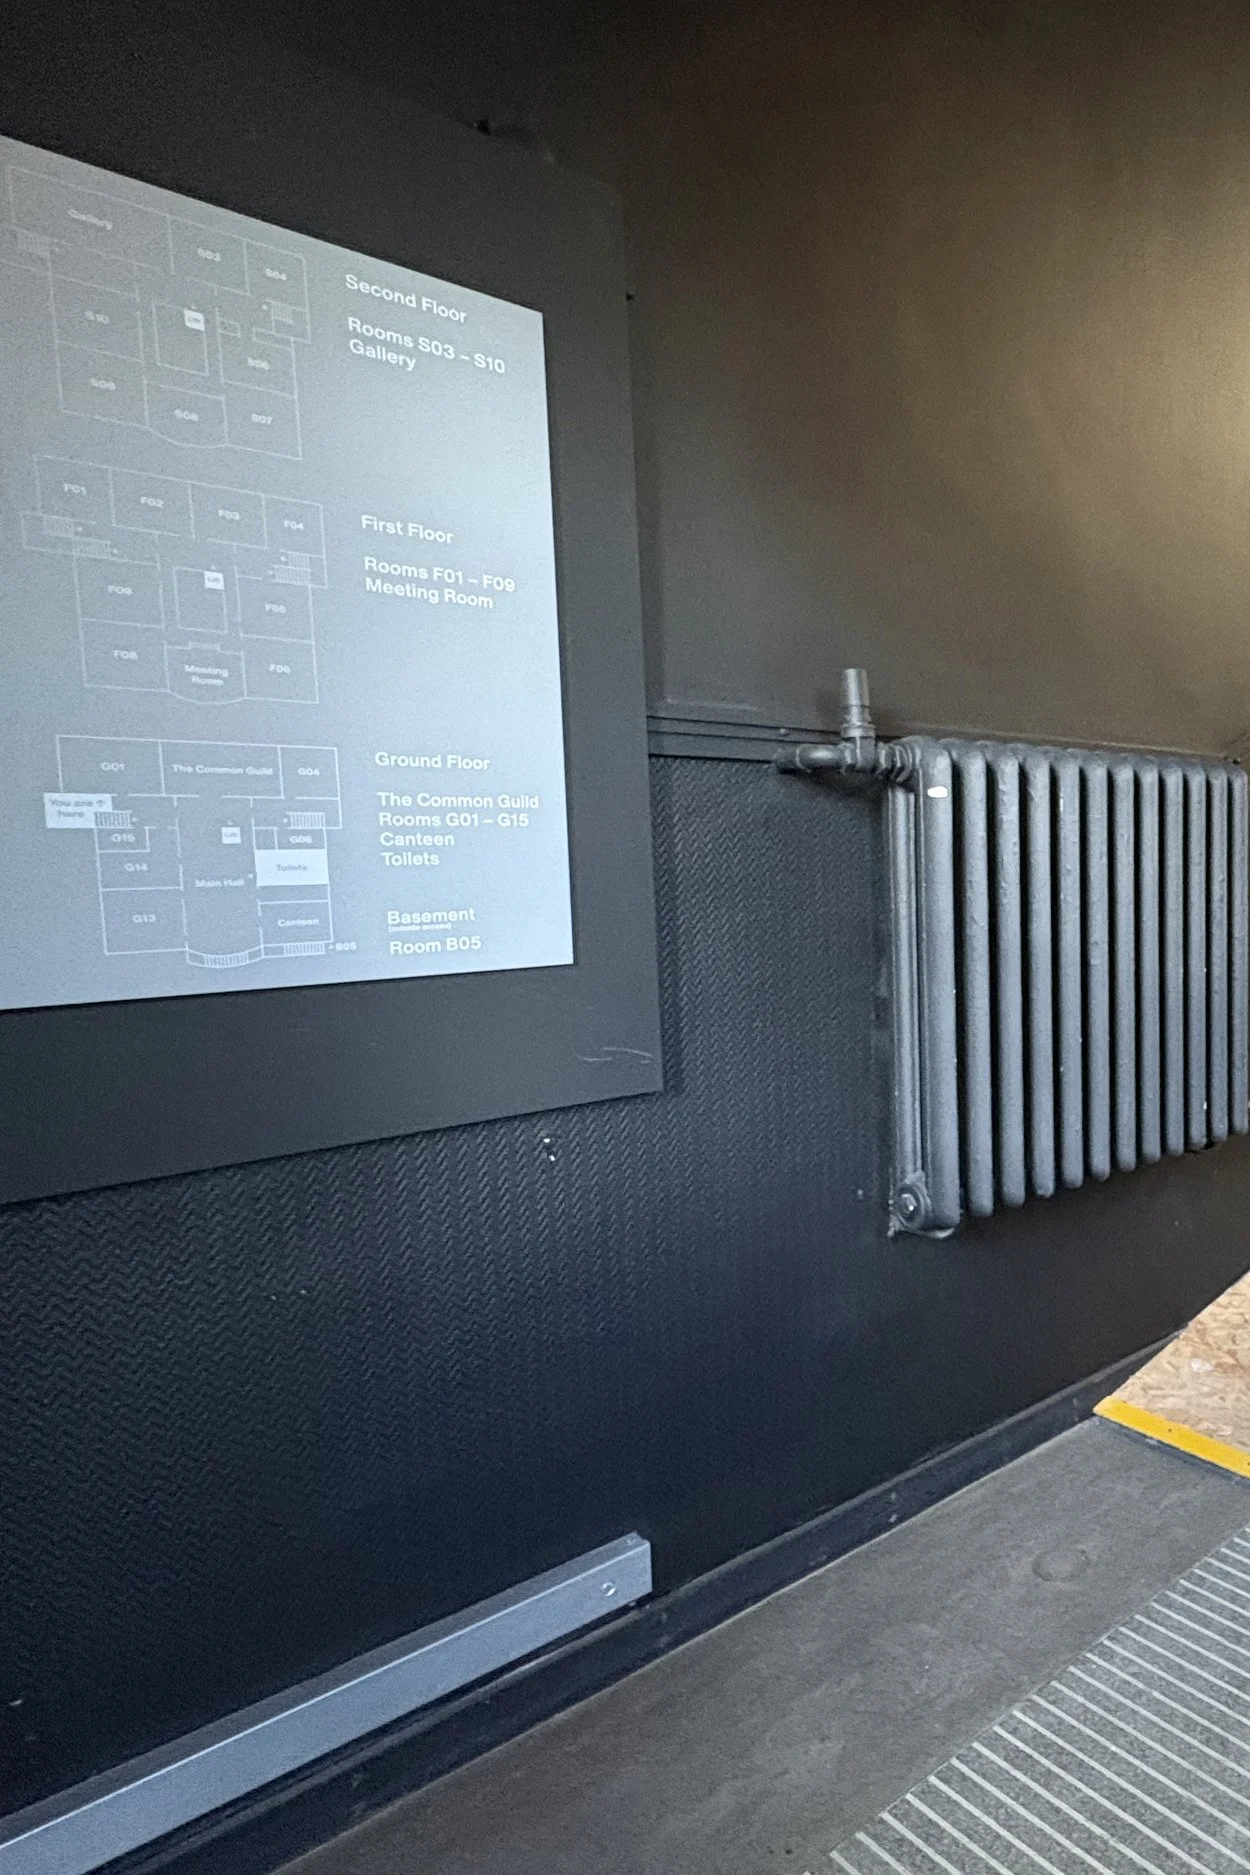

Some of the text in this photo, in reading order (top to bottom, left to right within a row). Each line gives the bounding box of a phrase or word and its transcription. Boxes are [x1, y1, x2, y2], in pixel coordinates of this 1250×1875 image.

[345, 274, 467, 324] Second Floor
[347, 317, 413, 348] Rooms
[417, 338, 455, 360] S03
[474, 353, 506, 374] S10
[349, 339, 417, 371] Gallery
[62, 482, 87, 496] F01
[140, 496, 164, 509] F02
[218, 508, 240, 521] F03
[284, 519, 304, 532] F04
[361, 514, 454, 545] First Floor
[364, 557, 429, 582] Rooms
[432, 567, 464, 586] F01
[482, 574, 516, 593] F09
[365, 578, 494, 609] Meeting Room
[101, 761, 124, 772] G01
[375, 751, 490, 771] Ground Floor
[172, 764, 273, 777] The Common Guild
[377, 791, 540, 810] The Common Guild
[379, 812, 442, 827] Rooms
[445, 812, 480, 827] G01
[497, 813, 529, 827] G15
[380, 831, 455, 847] Canteen
[381, 850, 440, 867] Toilets
[124, 862, 148, 873] G14
[132, 913, 156, 924] G13
[278, 917, 320, 928] Canteen
[387, 907, 476, 925] Basement
[389, 935, 482, 956] Room B05
